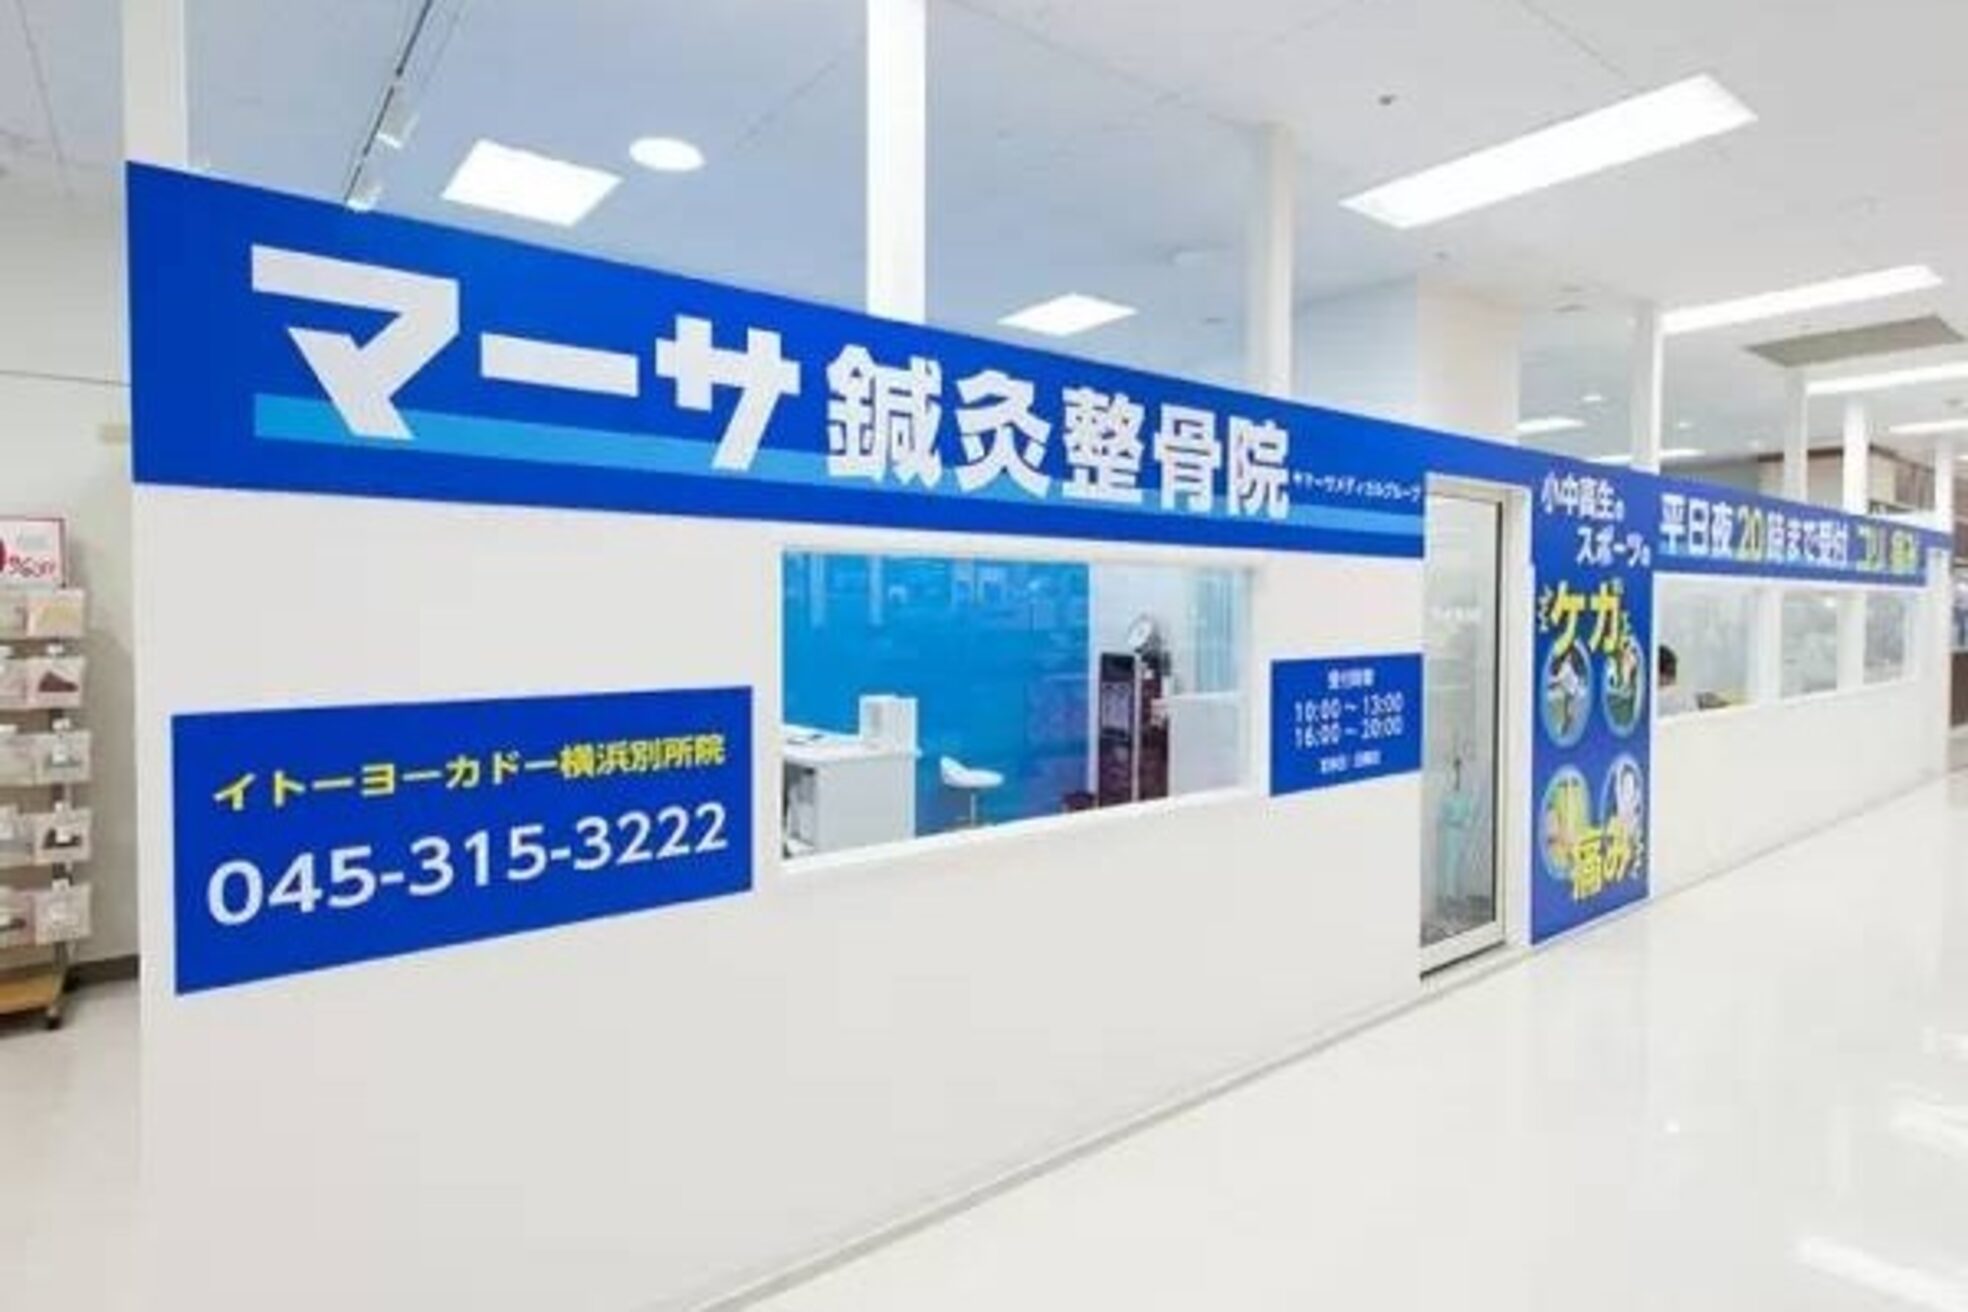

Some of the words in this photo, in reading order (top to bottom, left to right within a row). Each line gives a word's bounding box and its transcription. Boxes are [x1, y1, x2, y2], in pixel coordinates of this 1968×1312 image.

[251, 244, 1290, 520] マーサ鍼灸整骨院
[213, 733, 726, 811] イトーヨーカドー横浜別所院
[206, 801, 729, 926] 045-315-3222
